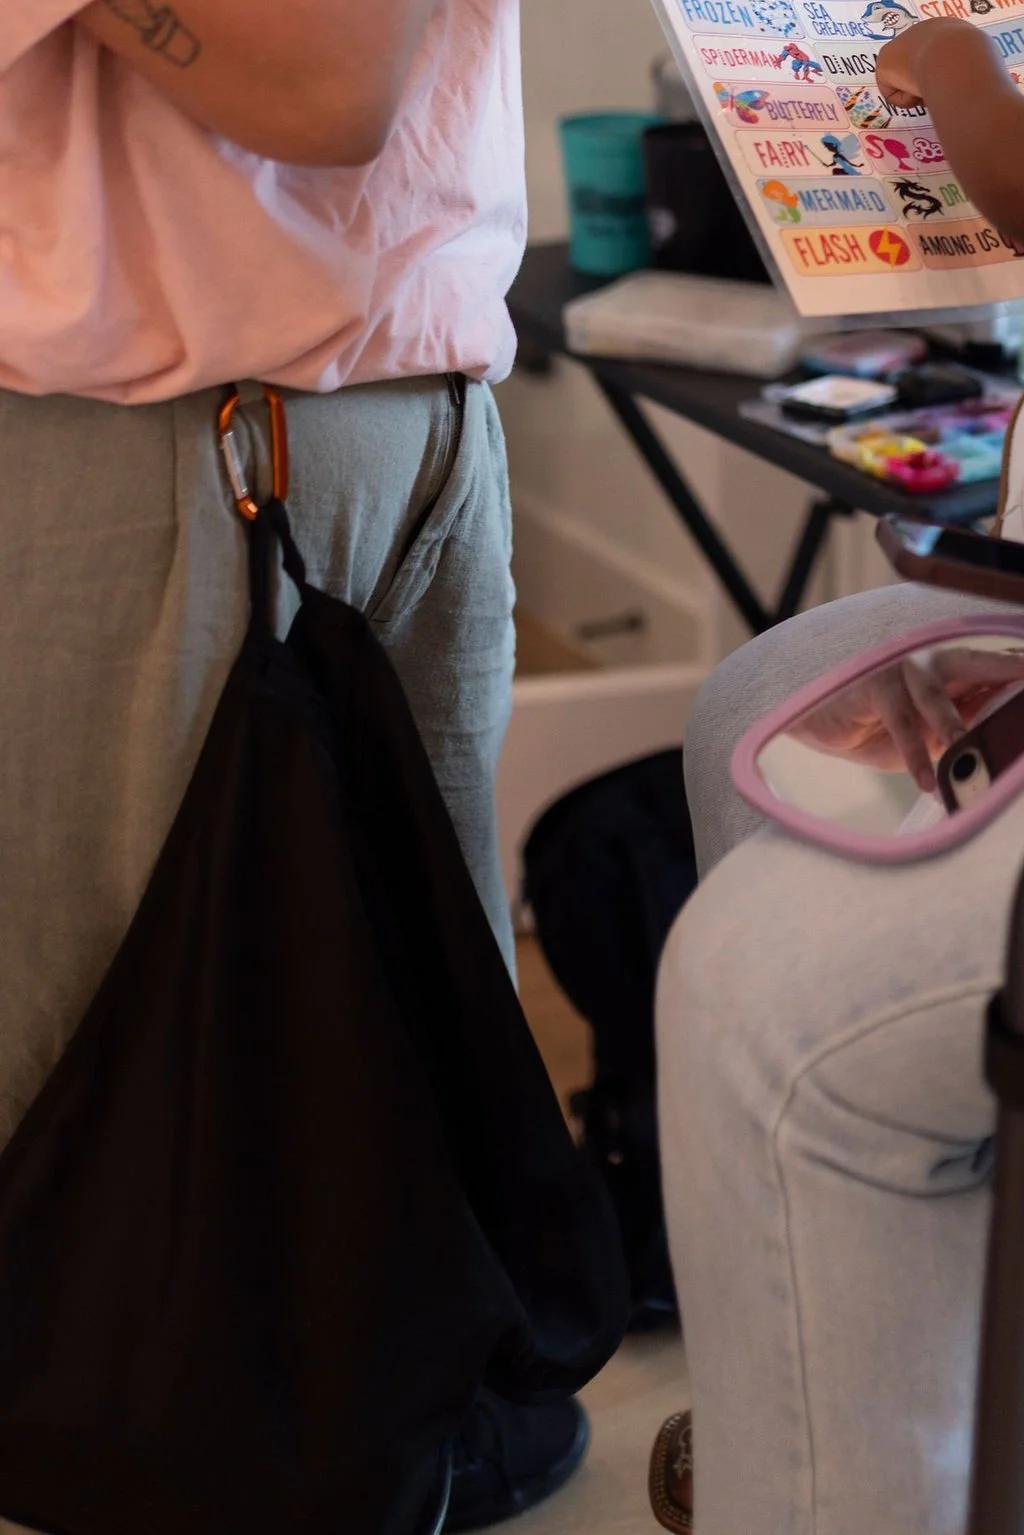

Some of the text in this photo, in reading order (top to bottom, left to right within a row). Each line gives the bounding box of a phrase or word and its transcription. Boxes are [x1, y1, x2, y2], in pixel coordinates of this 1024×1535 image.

[803, 2, 832, 22] SEA
[812, 20, 875, 37] CREATURES
[701, 47, 782, 70] SPIDERMAN
[822, 53, 878, 76] DINOS
[765, 100, 841, 122] BUTTERFLY
[753, 139, 811, 169] FAIRY
[798, 188, 887, 214] MERMAID
[792, 233, 868, 268] FLASH
[918, 228, 999, 257] AMONG US
